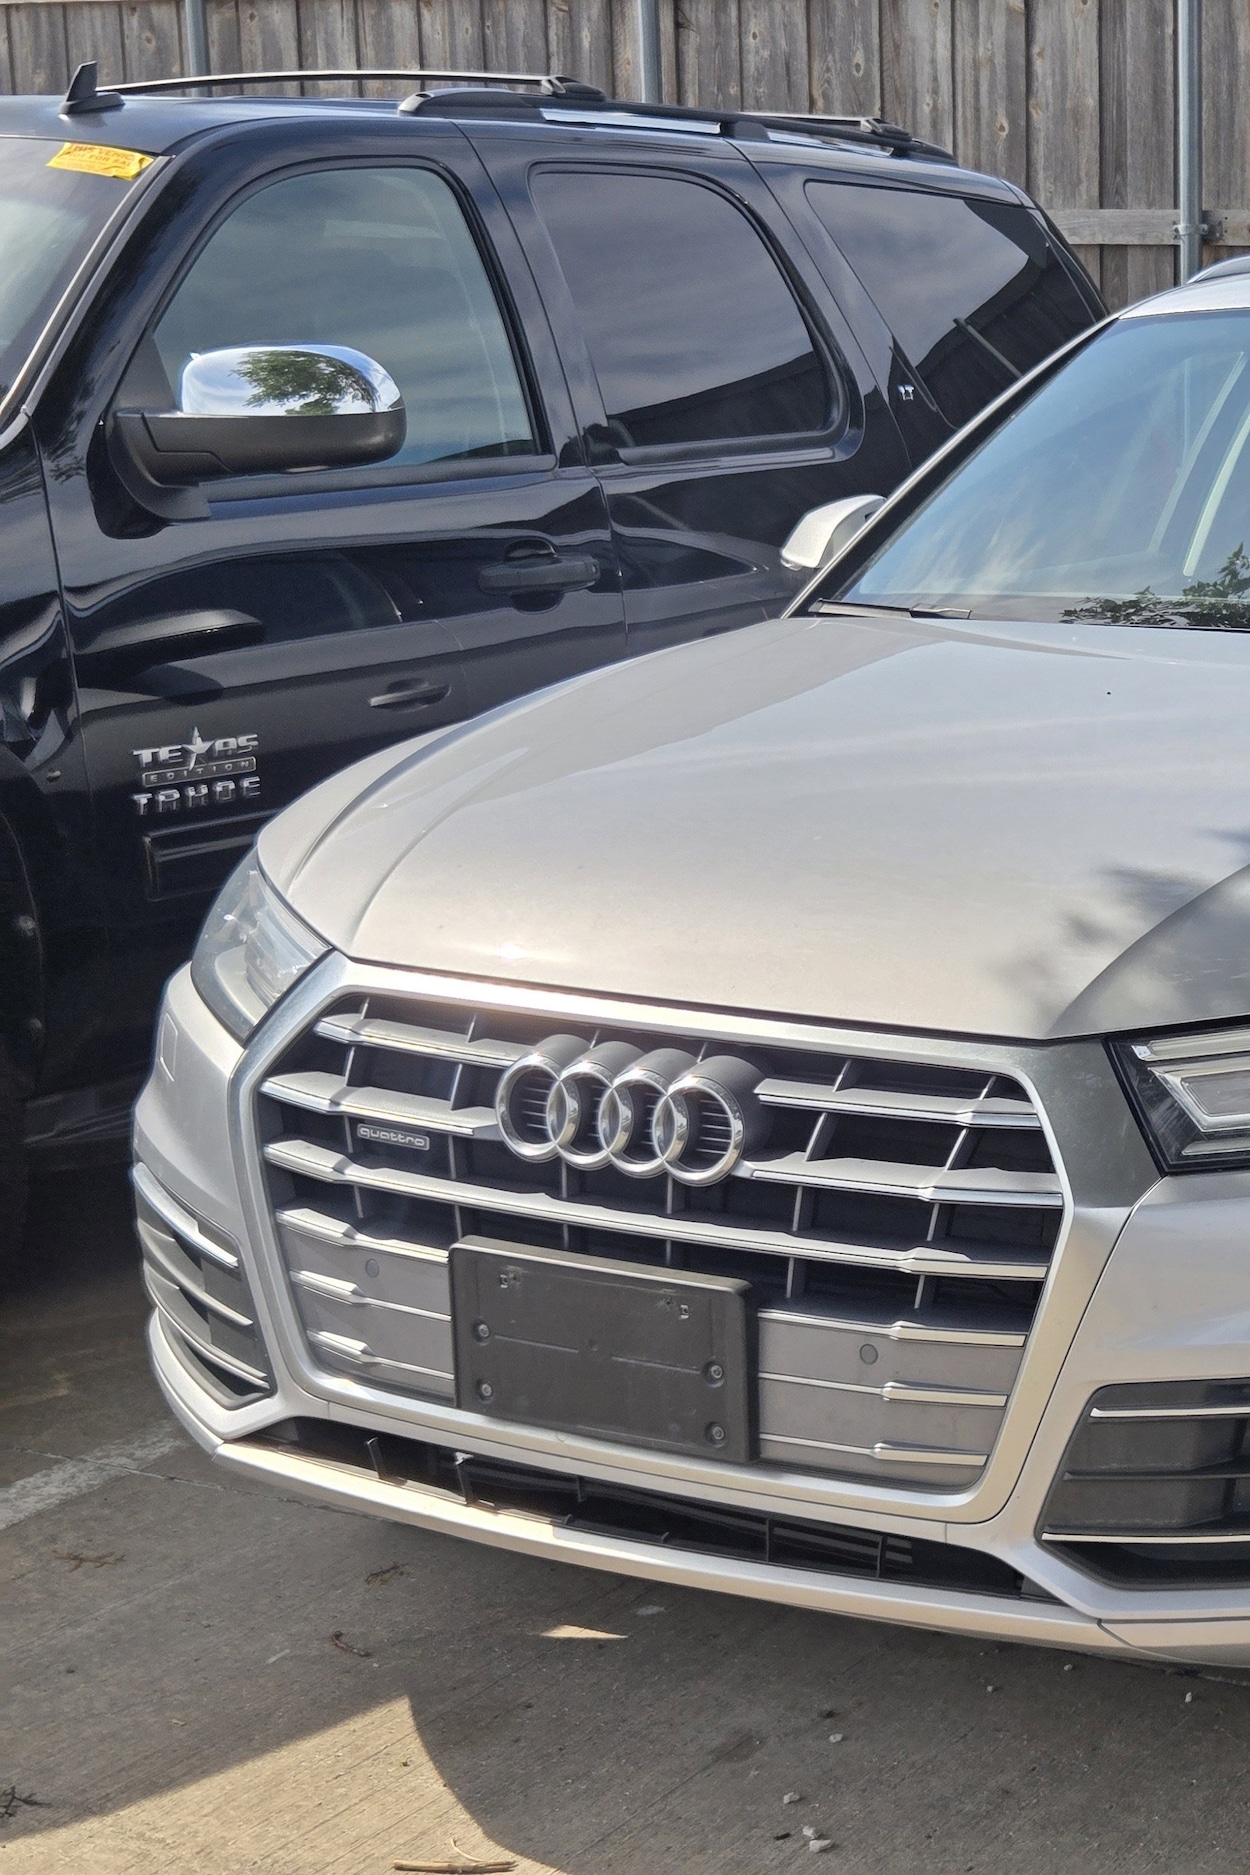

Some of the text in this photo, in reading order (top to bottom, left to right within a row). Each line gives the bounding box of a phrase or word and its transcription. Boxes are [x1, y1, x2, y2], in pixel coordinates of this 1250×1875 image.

[89, 154, 110, 163] FOR
[132, 727, 259, 770] TEXAS
[151, 760, 249, 783] EDITION
[132, 776, 261, 816] TAHOE
[360, 1127, 425, 1147] quattro
